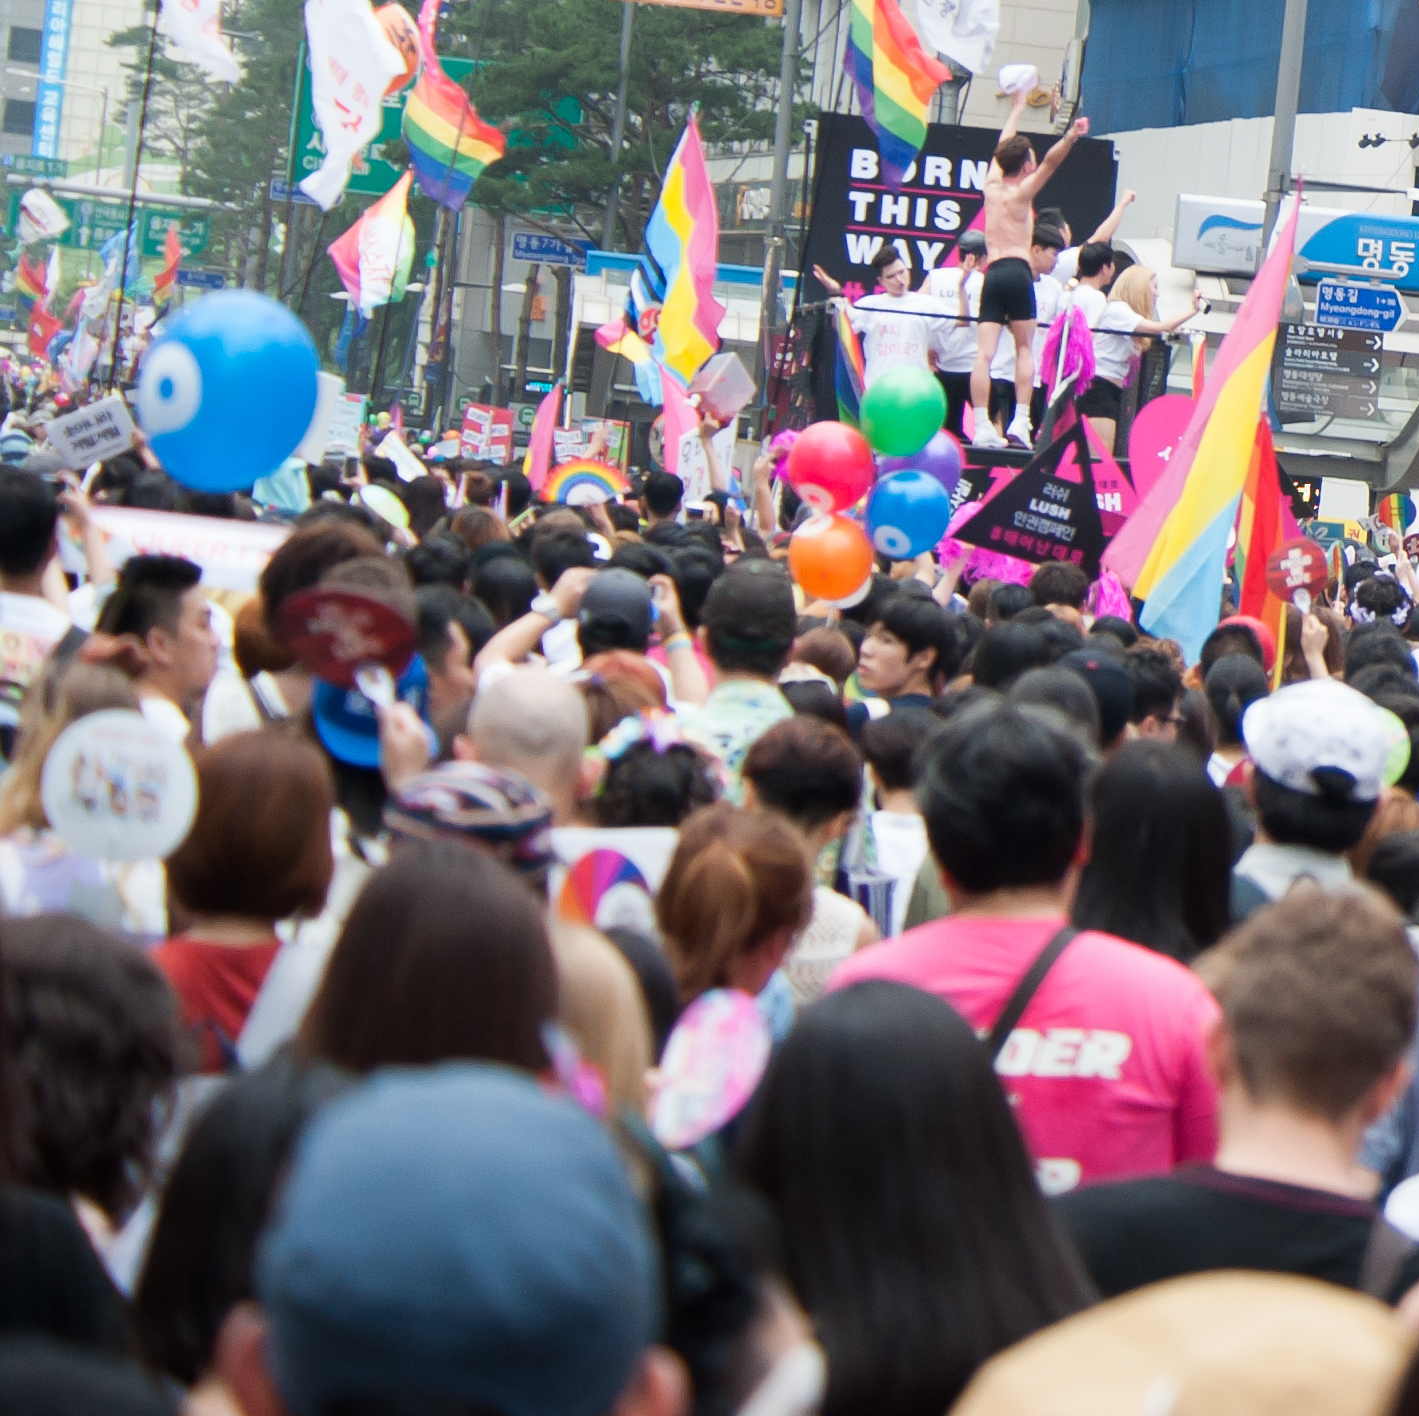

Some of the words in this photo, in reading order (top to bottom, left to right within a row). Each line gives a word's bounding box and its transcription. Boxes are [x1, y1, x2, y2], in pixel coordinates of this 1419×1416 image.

[850, 148, 989, 191] BRN
[848, 190, 962, 231] THIS
[1322, 287, 1359, 304] 명동길
[1321, 302, 1396, 320] Myeongdong-gil
[1029, 497, 1072, 521] LUSH
